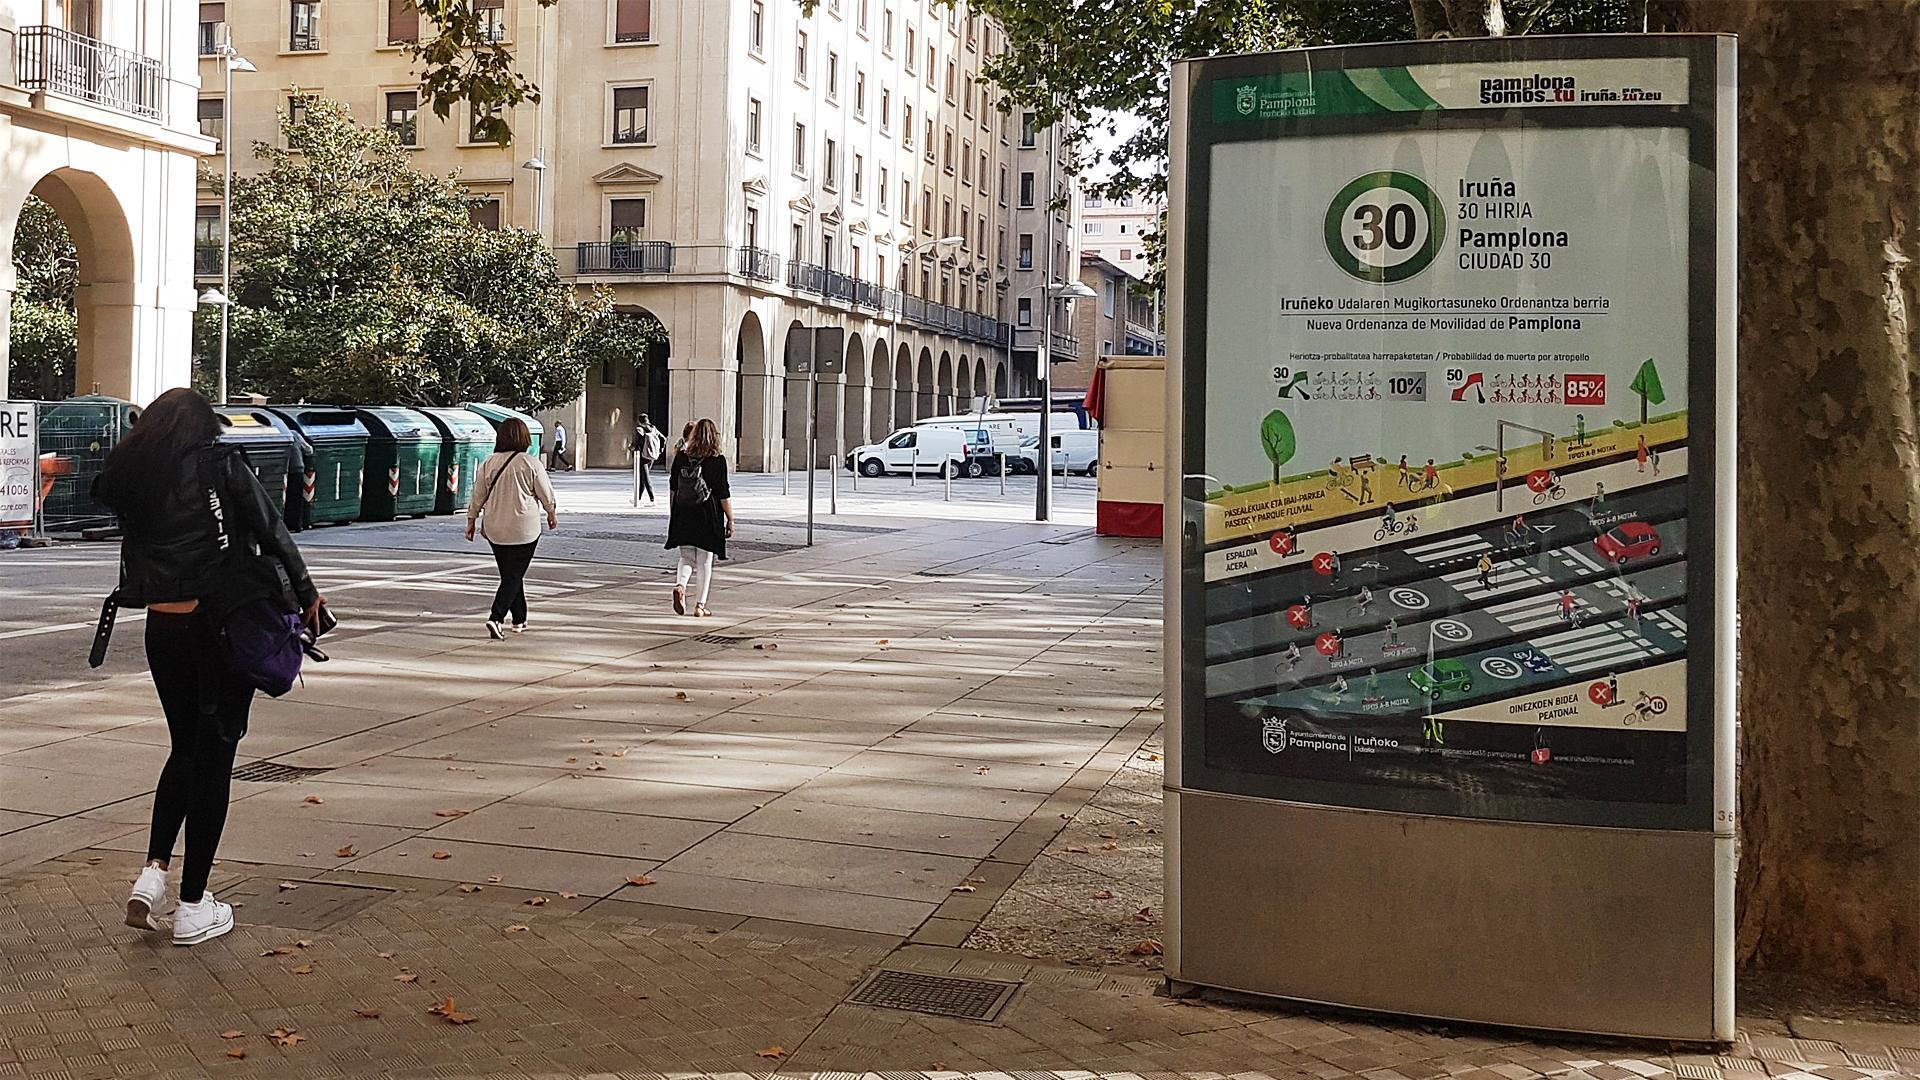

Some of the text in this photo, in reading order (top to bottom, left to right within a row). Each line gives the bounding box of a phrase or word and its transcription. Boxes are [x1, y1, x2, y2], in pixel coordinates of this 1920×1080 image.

[1480, 74, 1575, 91] pamplona
[1459, 178, 1516, 198] Iruña
[1458, 202, 1533, 220] 30 HIRIA
[1353, 204, 1417, 251] 30
[1459, 227, 1569, 252] Pamplona
[1459, 252, 1551, 270] CIUDAD 30
[1281, 296, 1609, 311] Iruñeko Udalaren Mugikortasuneko Ordenantza berria
[1307, 316, 1581, 332] Nueva Ordenanza de Movilidad de Pamplona
[1442, 352, 1492, 361] Probabilidad
[1537, 354, 1551, 362] por
[1273, 367, 1289, 379] 30
[1446, 369, 1463, 381] 50
[1388, 377, 1422, 395] 10%
[1567, 381, 1604, 398] 85%
[1224, 502, 1270, 518] PASEALEKUAK
[1270, 499, 1284, 510] ETA
[1225, 516, 1251, 528] PASEOS
[1258, 511, 1285, 522] PARQUE
[1286, 503, 1314, 516] FLUVIAL
[1226, 548, 1258, 561] ESPALOIA
[1226, 561, 1248, 572] ACERA
[1398, 592, 1421, 605] 50
[1438, 623, 1464, 638] 30
[1489, 661, 1512, 675] 20
[1509, 693, 1579, 714] OINEZKOEN BIDEA
[1653, 700, 1664, 710] 10
[1538, 707, 1579, 721] PEATONAL
[1290, 730, 1336, 740] Ayuntamiento
[1354, 735, 1399, 748] Iruñeko
[1289, 737, 1347, 752] Pamplona
